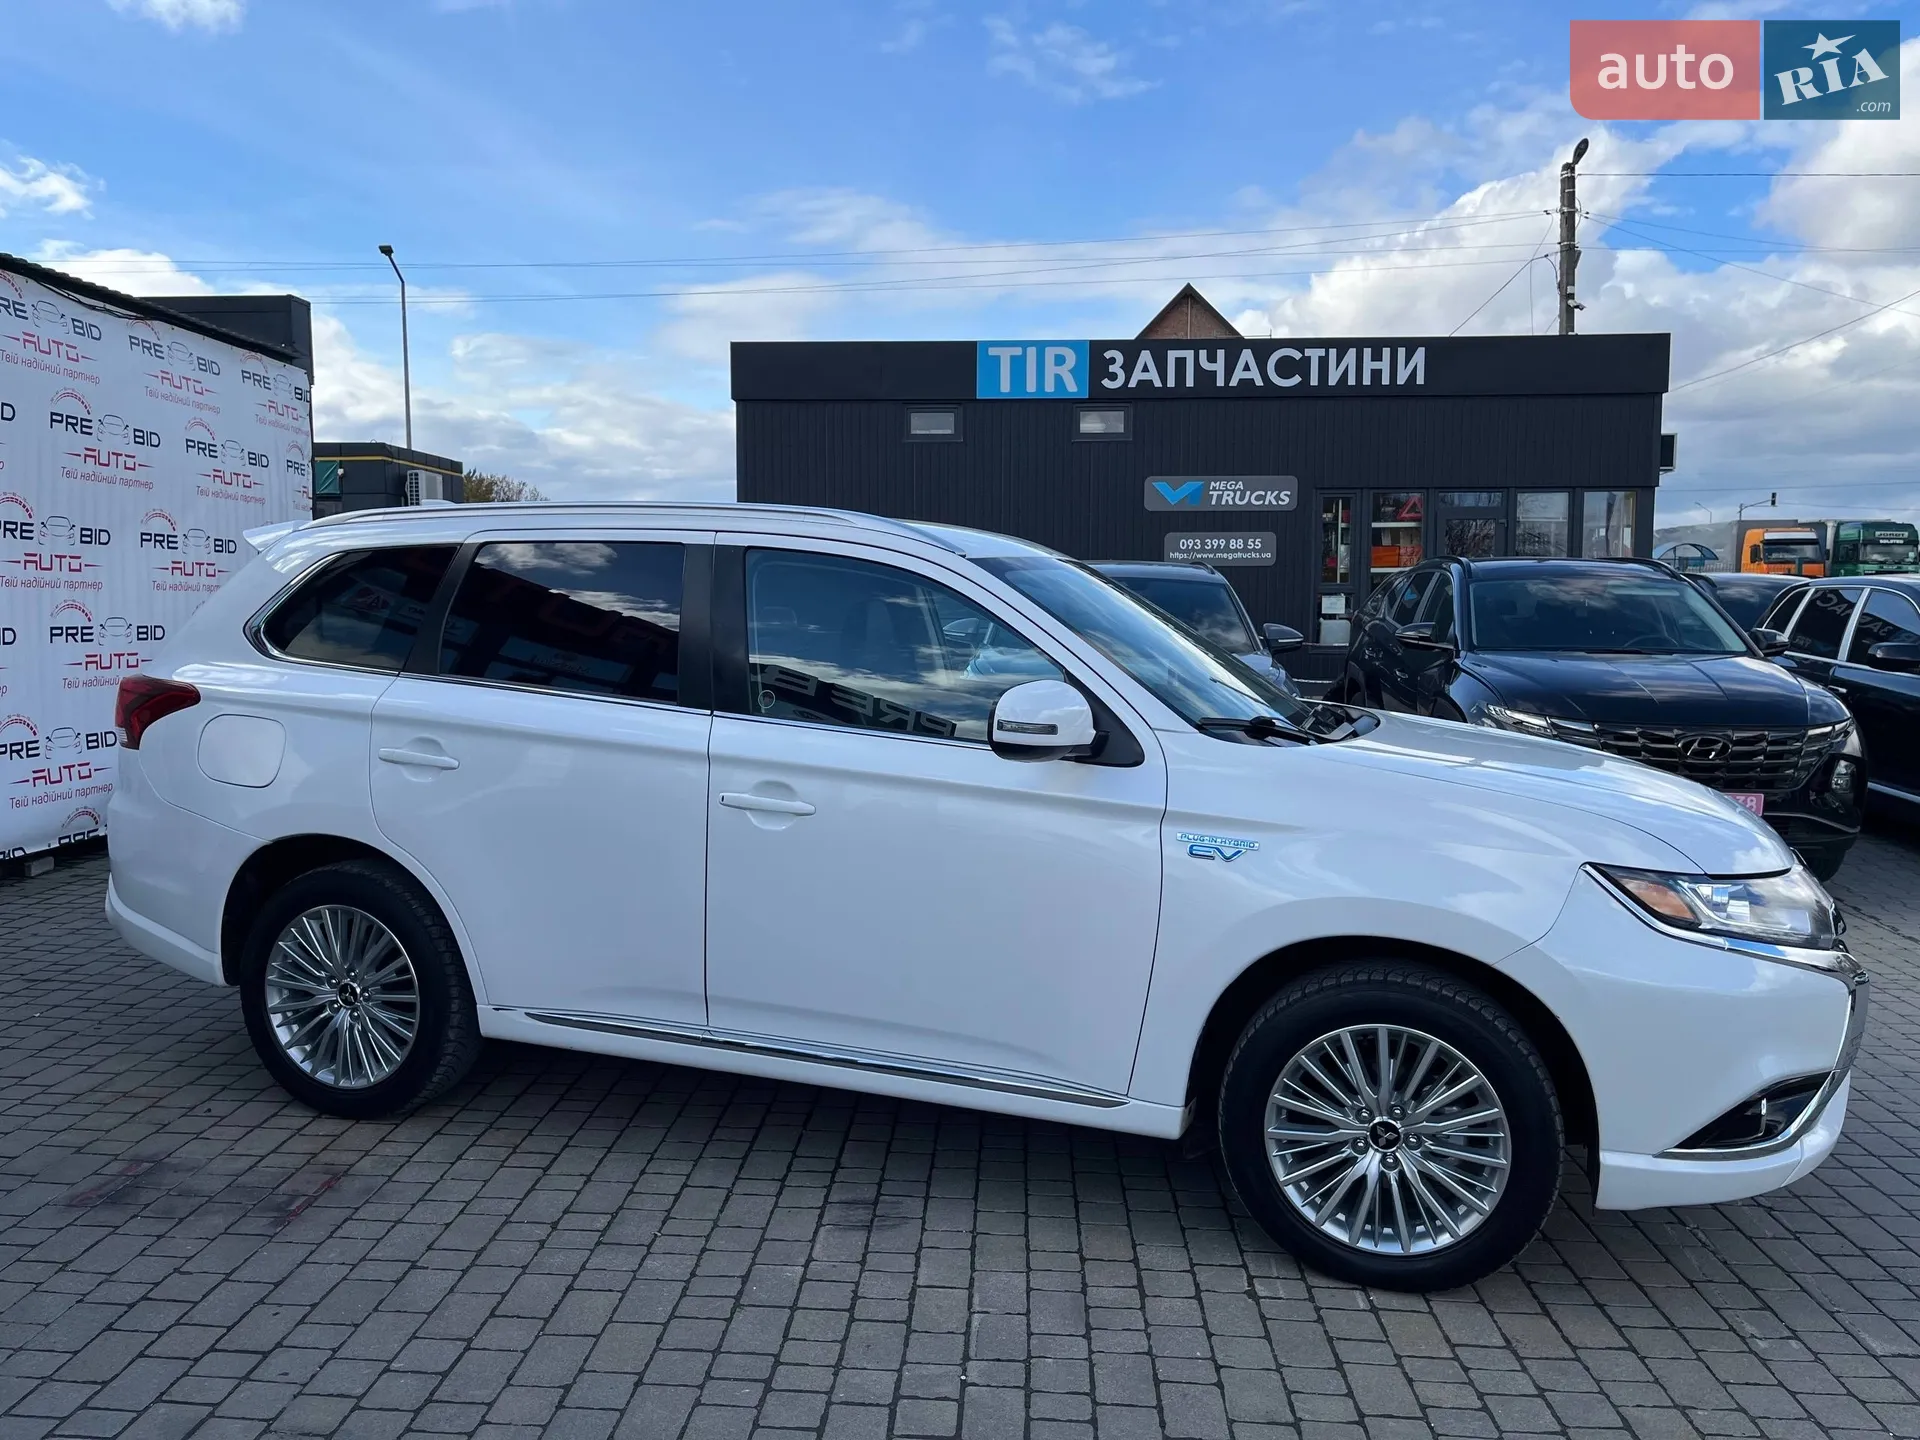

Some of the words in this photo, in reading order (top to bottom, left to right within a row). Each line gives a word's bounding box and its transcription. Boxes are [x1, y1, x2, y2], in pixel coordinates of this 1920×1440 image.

[71, 317, 102, 341] BID
[22, 331, 80, 363] AUTO
[129, 335, 164, 360] PRE
[197, 356, 220, 376] BID
[0, 348, 19, 365] Твій
[21, 357, 61, 375] надійний
[63, 367, 101, 386] партнер
[988, 346, 1078, 393] TIR
[1101, 346, 1426, 389] ЗАПЧАСТИНИ
[160, 369, 204, 396] AUTO
[241, 369, 272, 391] PRE
[144, 386, 159, 399] Твій
[161, 390, 190, 406] надійний
[192, 399, 220, 415] партнер
[268, 399, 299, 421] AUTO
[50, 411, 93, 436] PRE
[133, 427, 160, 448] BID
[84, 447, 136, 471] AUTO
[185, 438, 218, 459] PRE
[248, 451, 269, 468] BID
[61, 466, 78, 480] Твій
[80, 471, 117, 485] надійний
[119, 477, 154, 491] партнер
[212, 469, 252, 489] AUTO
[287, 459, 306, 477] PRE
[196, 485, 210, 497] Твій
[1209, 481, 1244, 490] MEGA
[1209, 490, 1291, 506] TRUCKS
[0, 520, 34, 540] RE
[80, 527, 111, 546] BID
[140, 532, 179, 550] PRE
[214, 538, 237, 554] BID
[1179, 538, 1201, 550] 093
[1204, 538, 1226, 550] 399
[1229, 538, 1244, 549] 88
[1247, 538, 1262, 549] 55
[23, 552, 82, 572] AUTO
[1169, 551, 1272, 560] https://www.megatrucks.ua
[171, 560, 216, 577] AUTO
[0, 575, 18, 588] Твій
[20, 576, 60, 589] надійний
[63, 578, 103, 592] партнер
[152, 580, 167, 592] Твій
[169, 581, 201, 592] надійний
[49, 625, 95, 643] PRE
[136, 625, 165, 641] BID
[85, 652, 139, 671] AUTO
[62, 676, 80, 689] Твій
[82, 674, 120, 688] надійний
[86, 731, 117, 750] BID
[32, 761, 92, 787] AUTO
[9, 795, 28, 809] Твій
[31, 787, 73, 806] надійний
[75, 783, 113, 798] партнер
[1187, 843, 1245, 861] EV
